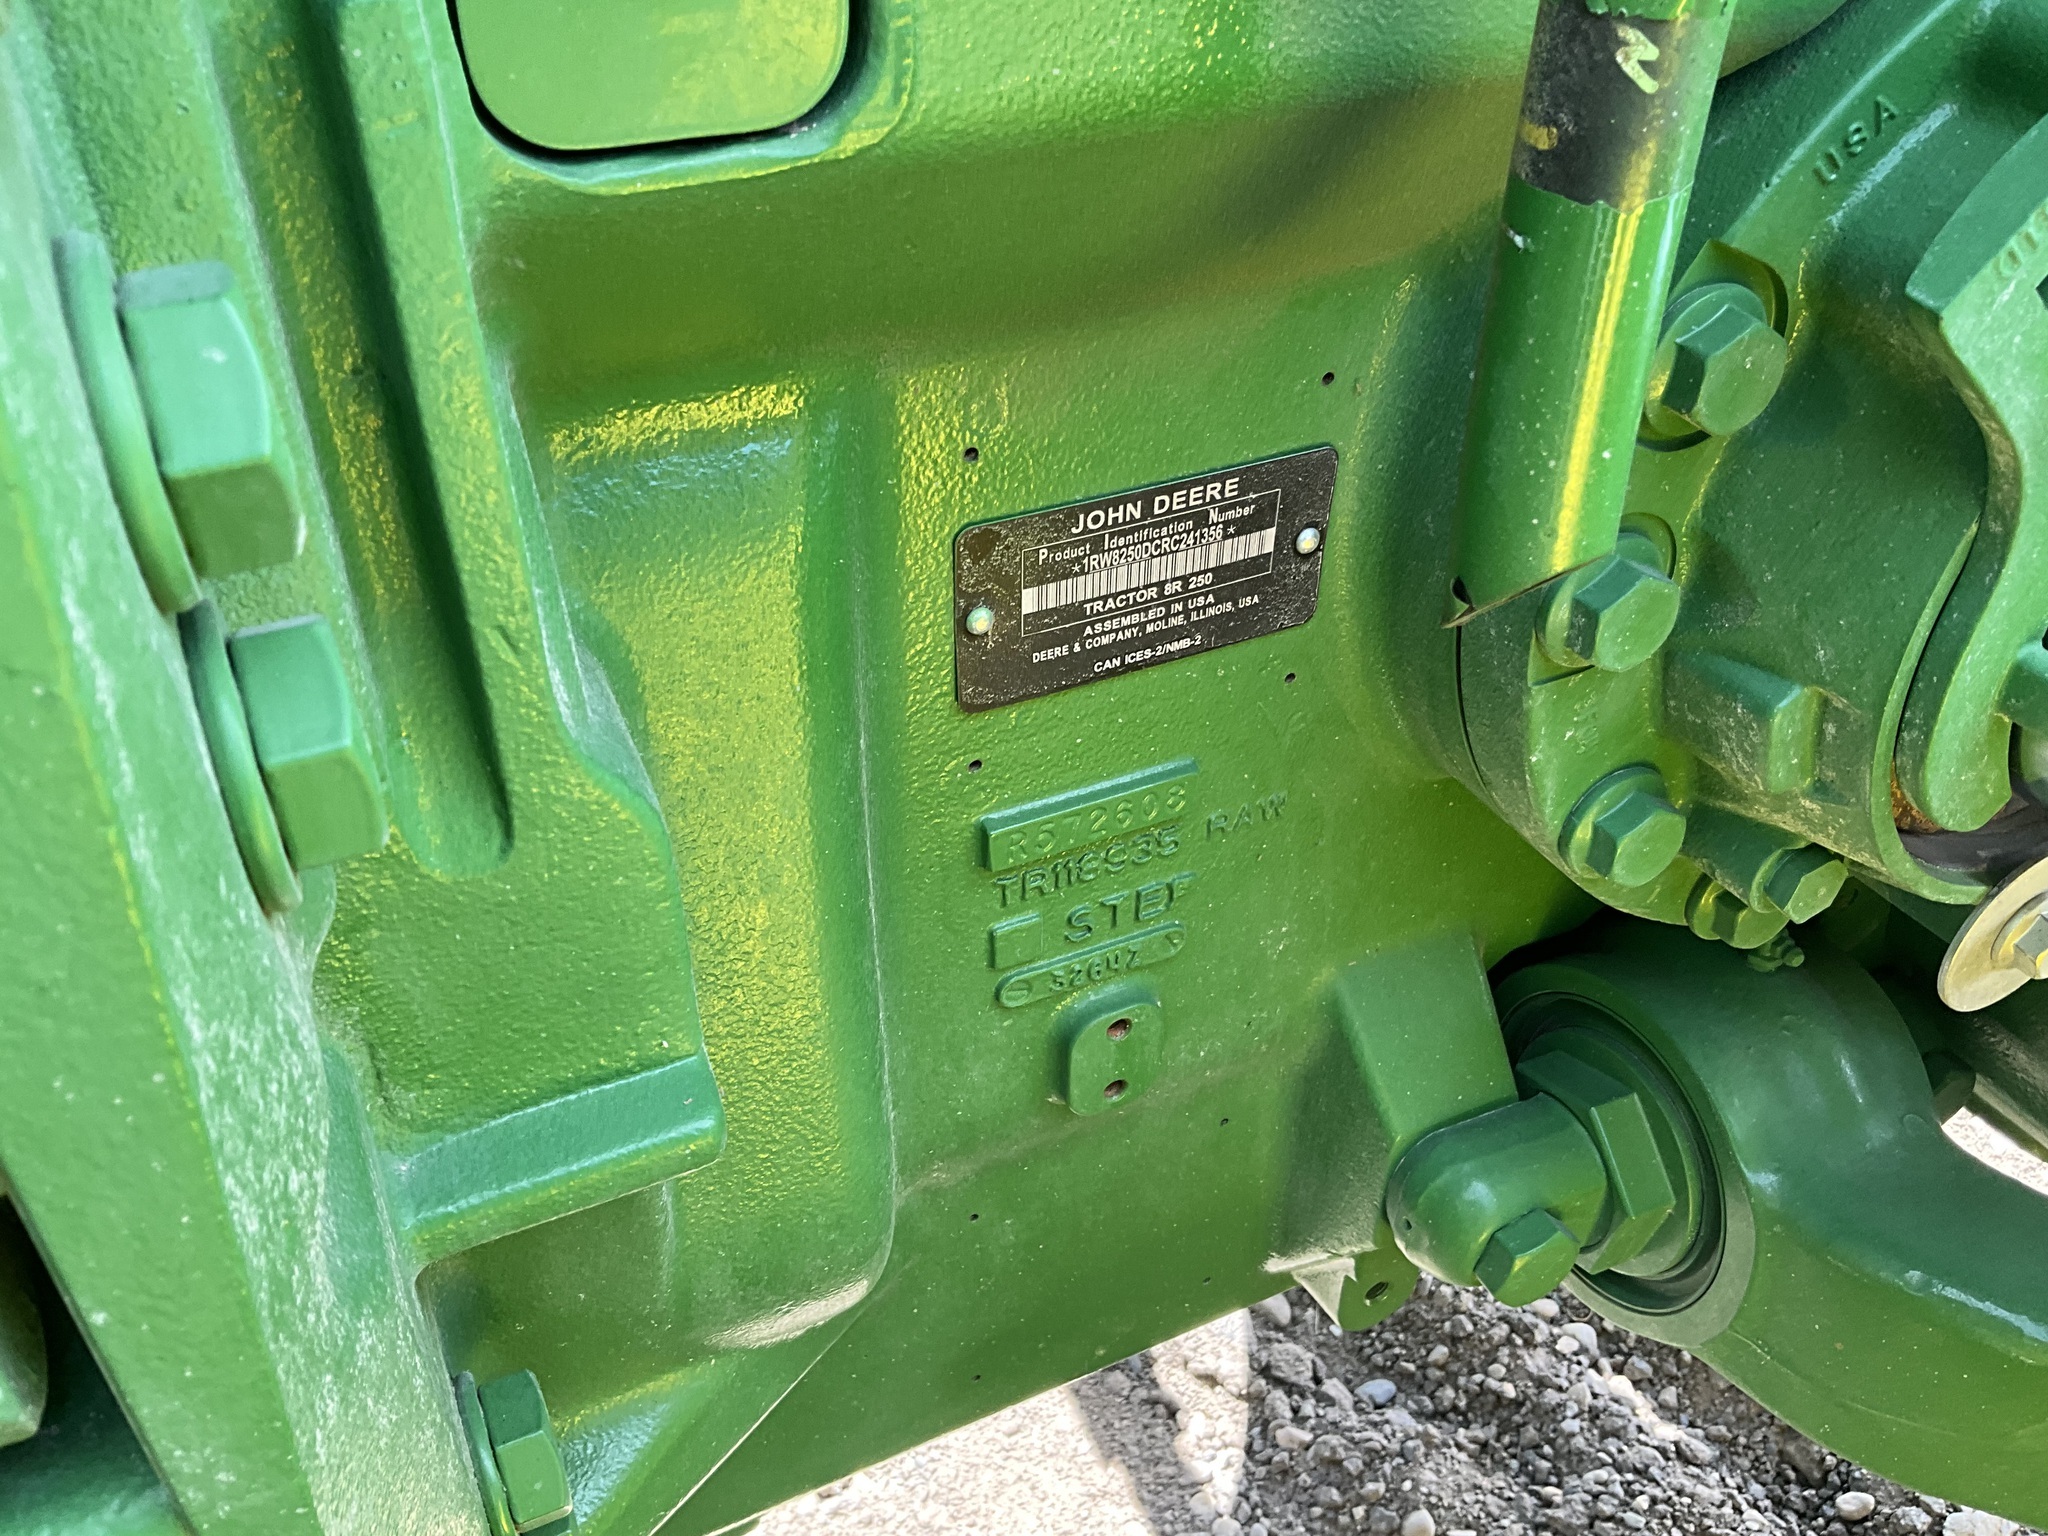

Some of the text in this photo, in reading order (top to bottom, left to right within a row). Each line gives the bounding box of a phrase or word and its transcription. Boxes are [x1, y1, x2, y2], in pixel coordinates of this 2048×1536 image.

[1812, 94, 1901, 185] USA
[1038, 504, 1256, 566] Product Identification Number
[1071, 477, 1240, 534] JOHN DEERE
[1083, 572, 1213, 615] TRACTOR 8R 250
[1083, 594, 1215, 637] ASSEMBLED IN USA
[1032, 594, 1260, 663] DEERE & COMPANY, MOLINE, ILLINOIS, USA
[1093, 635, 1202, 673] CAN ICES-2/NMB-2
[1008, 784, 1187, 863] R572608
